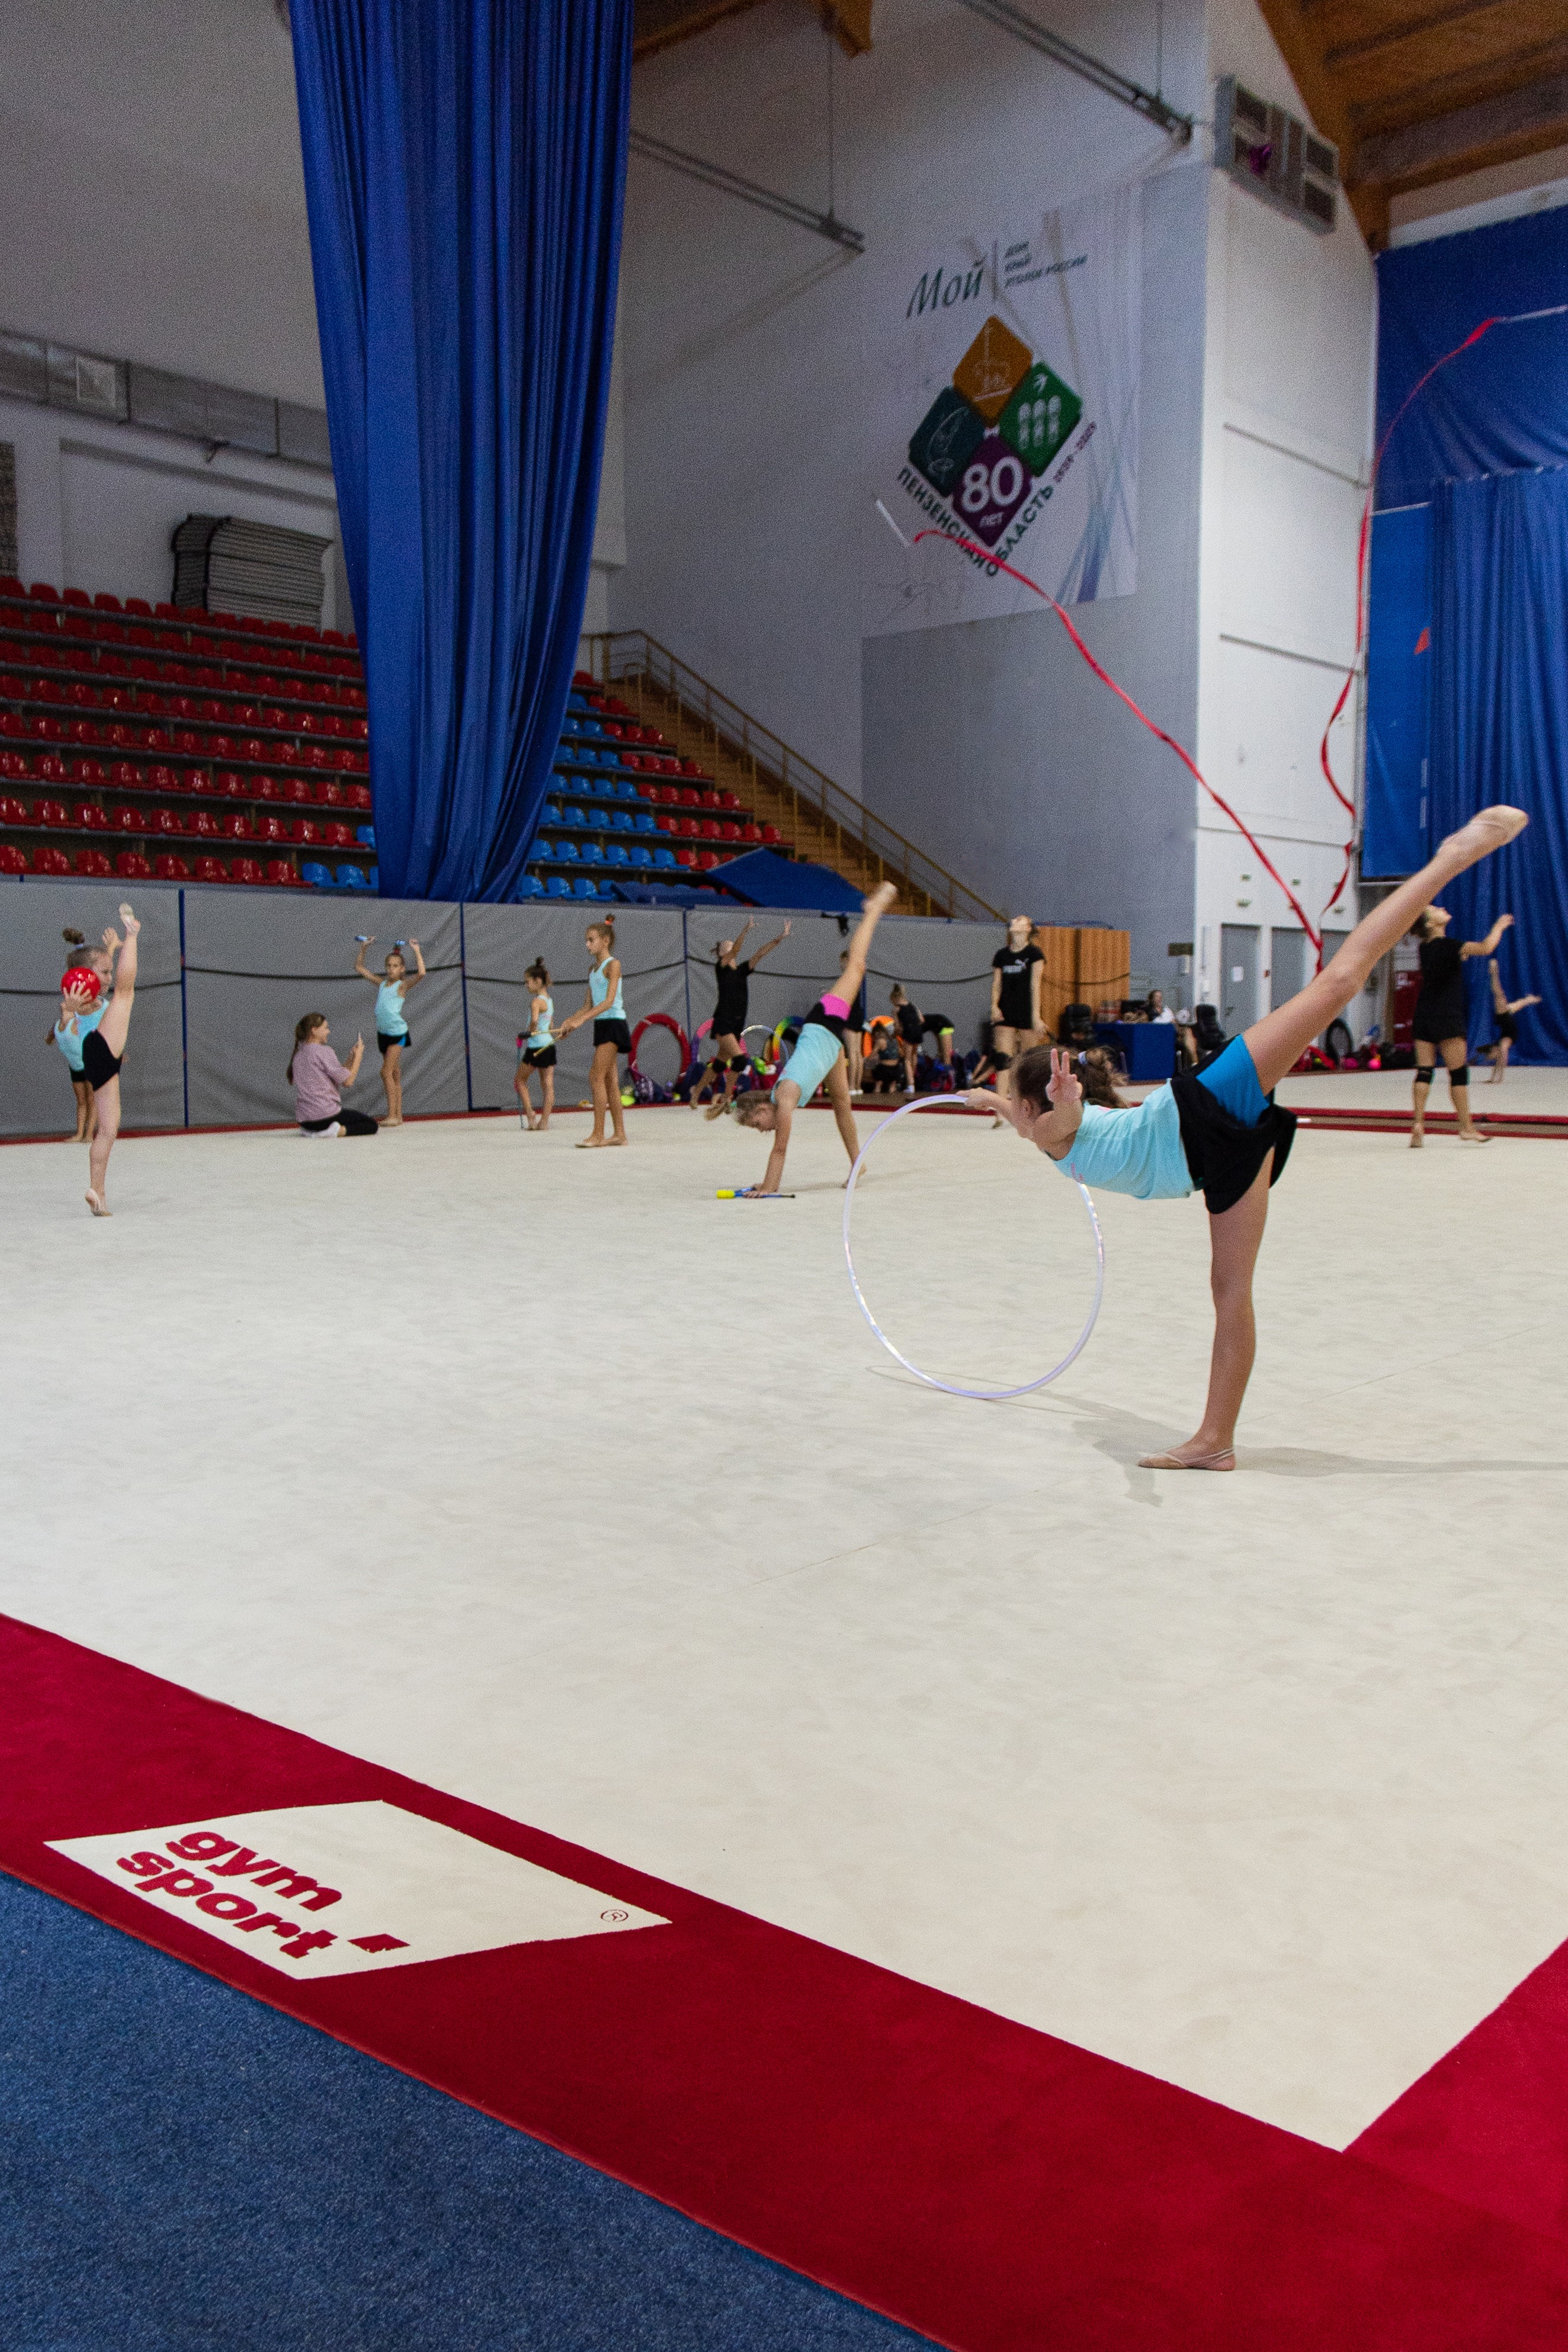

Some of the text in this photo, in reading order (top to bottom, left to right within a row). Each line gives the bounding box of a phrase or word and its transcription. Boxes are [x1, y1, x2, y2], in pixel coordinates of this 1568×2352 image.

[906, 256, 987, 319] Мой
[961, 456, 1023, 513] 80
[986, 485, 1054, 577] ОБЛАСТЬ
[116, 1851, 338, 1959] sport
[166, 1831, 342, 1912] gym
